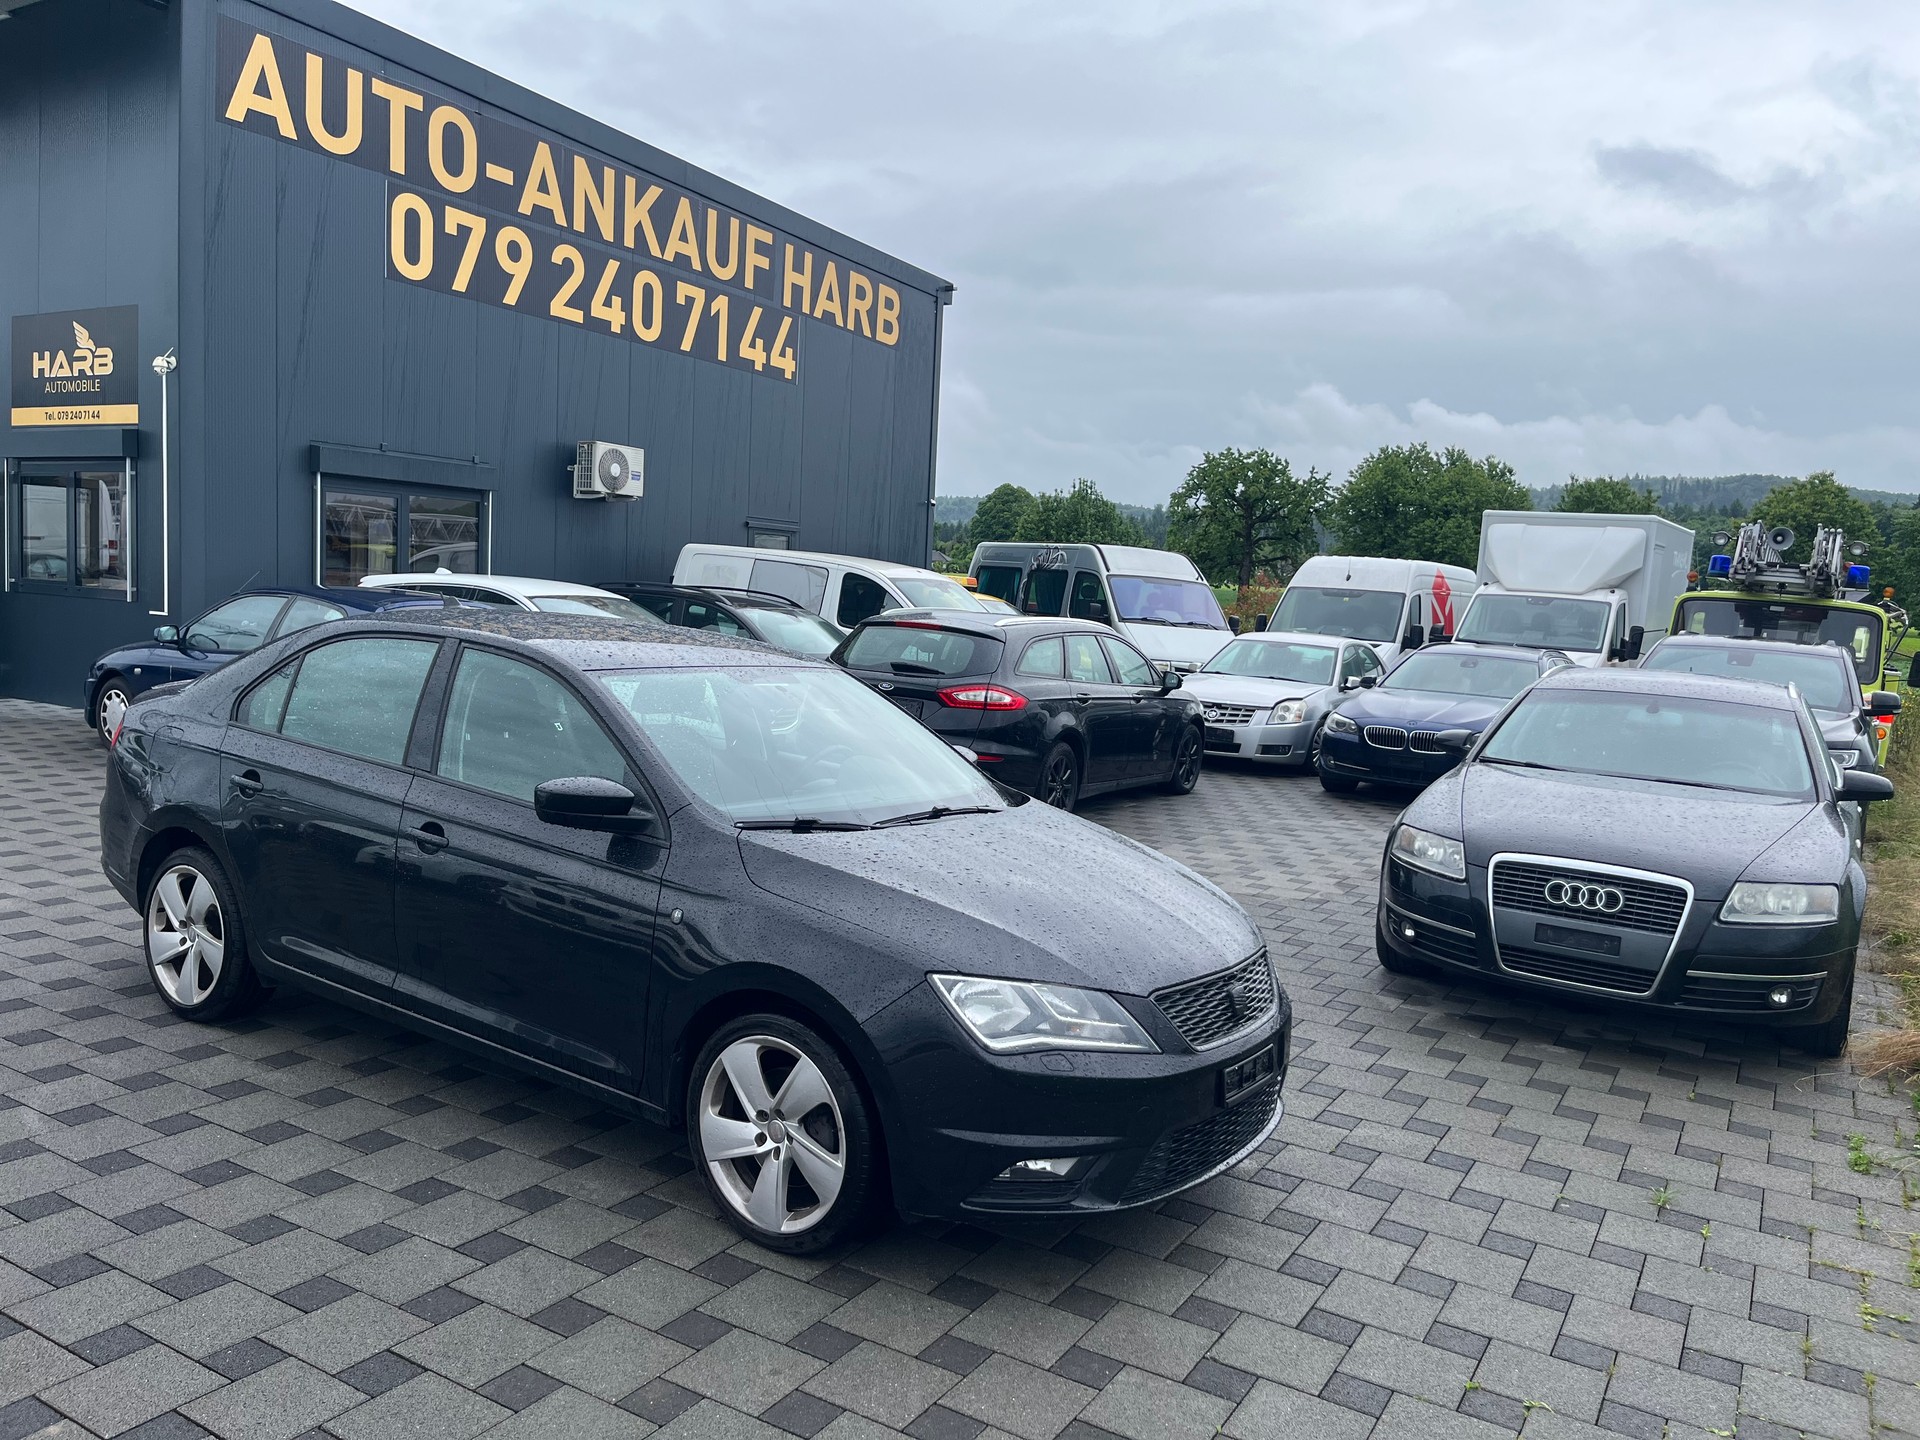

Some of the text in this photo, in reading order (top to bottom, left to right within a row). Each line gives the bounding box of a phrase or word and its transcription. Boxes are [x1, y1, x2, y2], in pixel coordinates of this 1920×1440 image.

[225, 34, 901, 346] AUTO-ANKAUF HARB
[391, 192, 533, 307] 079
[549, 243, 663, 342] 240
[33, 347, 113, 378] HARB
[45, 380, 100, 393] AUTOMOBILE
[45, 412, 56, 420] Tel.
